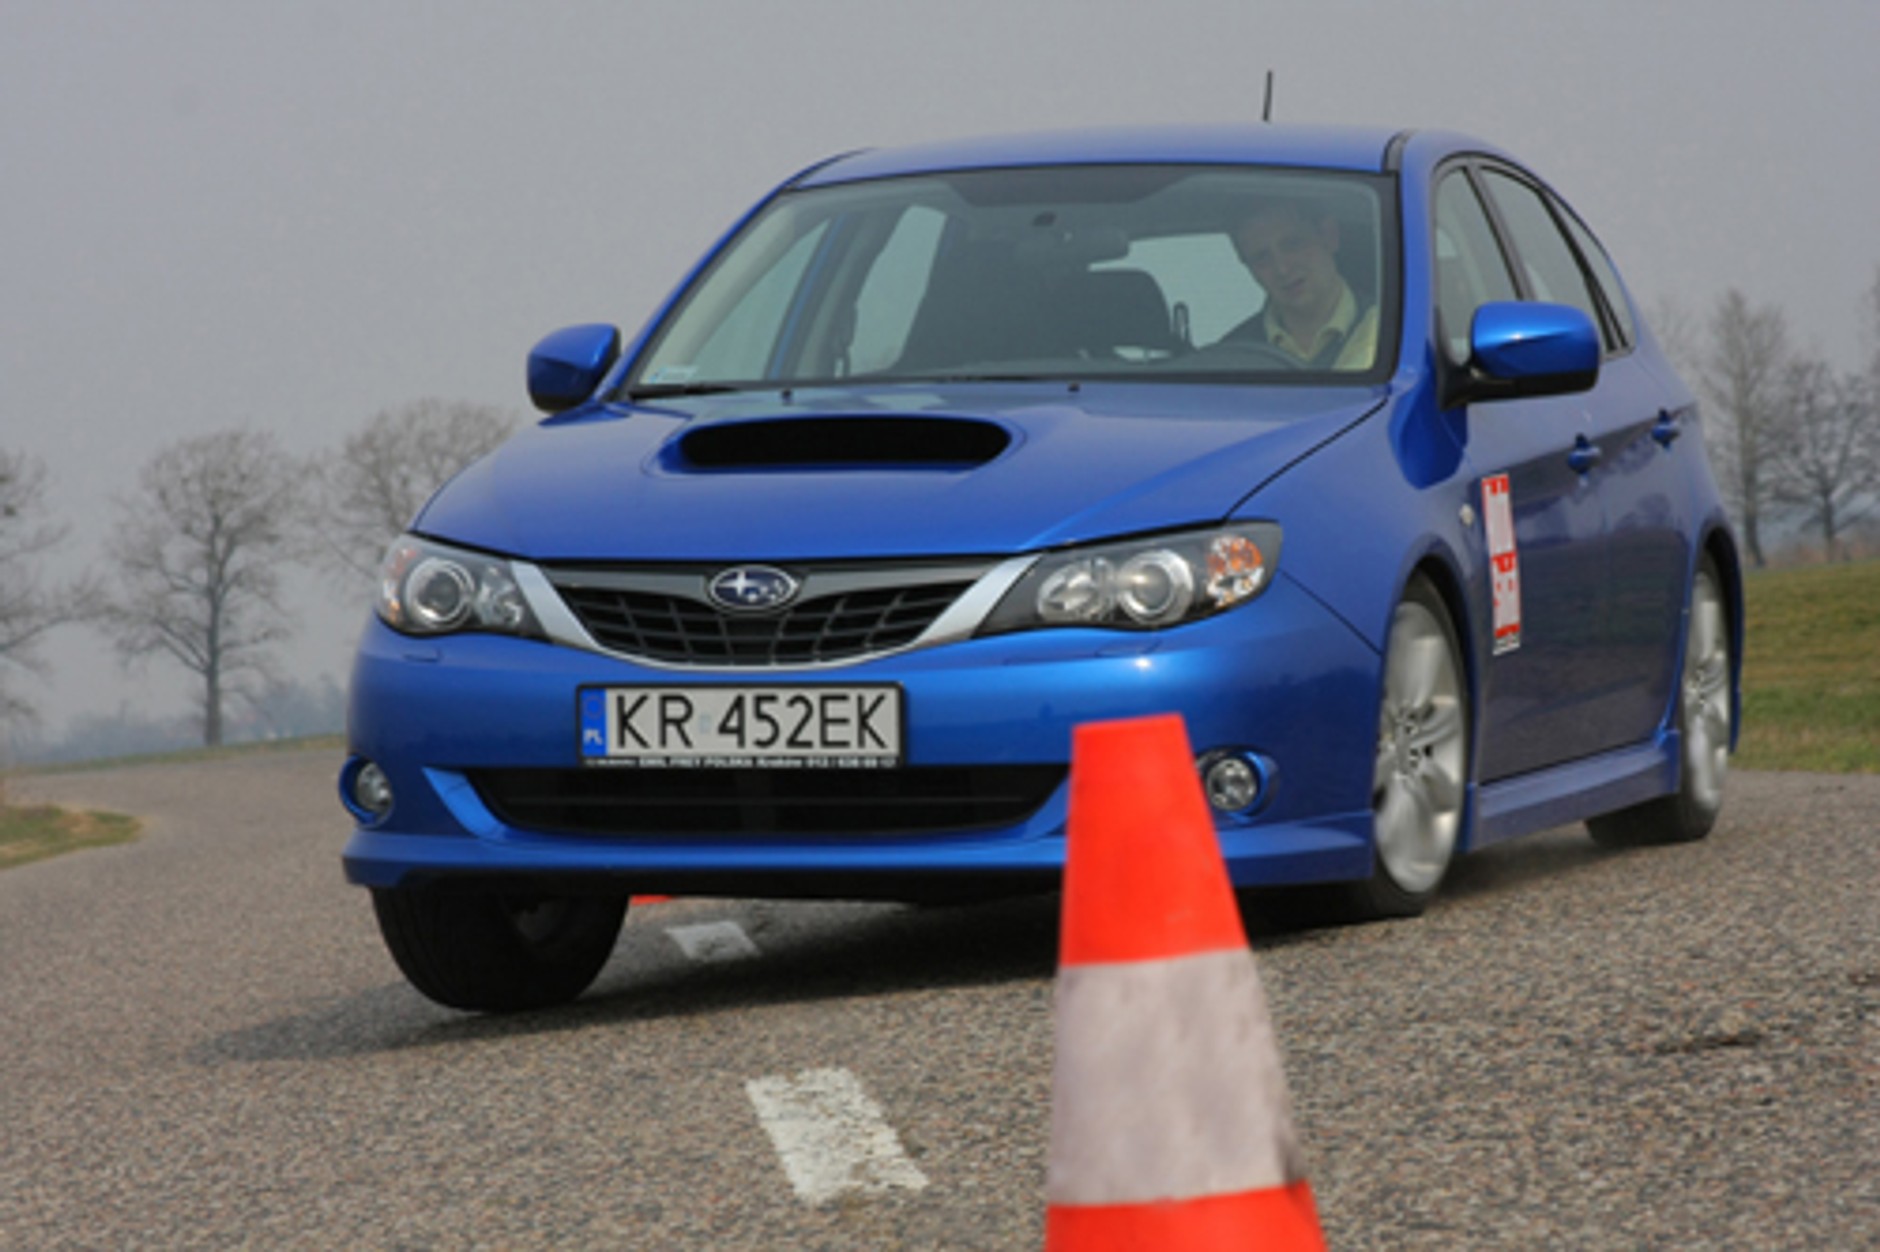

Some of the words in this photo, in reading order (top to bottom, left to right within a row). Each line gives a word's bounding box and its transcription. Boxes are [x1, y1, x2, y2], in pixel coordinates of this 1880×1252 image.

[583, 728, 603, 746] PL
[616, 693, 694, 749] KR
[717, 693, 889, 749] 452EK
